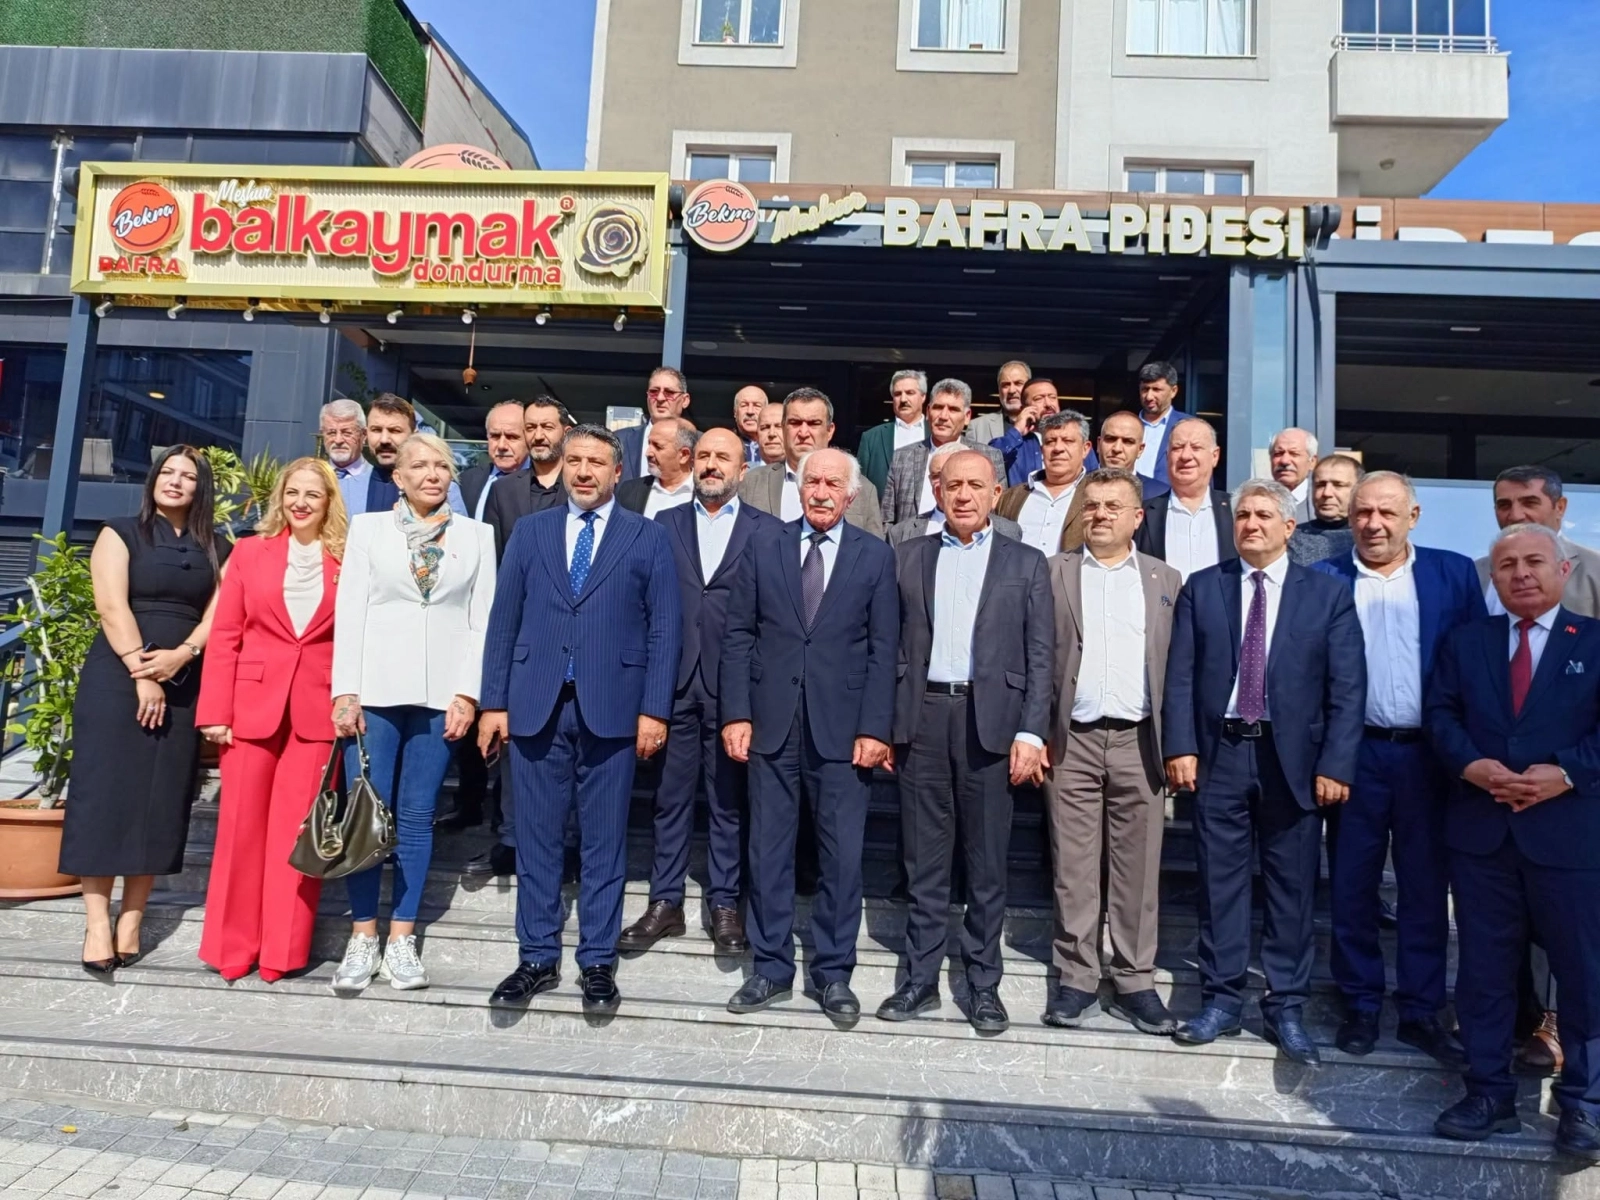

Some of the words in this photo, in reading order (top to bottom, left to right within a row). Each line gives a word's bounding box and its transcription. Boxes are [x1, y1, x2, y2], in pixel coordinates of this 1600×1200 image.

[112, 203, 176, 238] Bekra
[684, 200, 755, 229] Bekra
[883, 196, 1092, 251] BAFRA
[190, 196, 562, 275] balkaymak
[98, 255, 180, 275] BAFRA
[412, 257, 563, 285] dondurma
